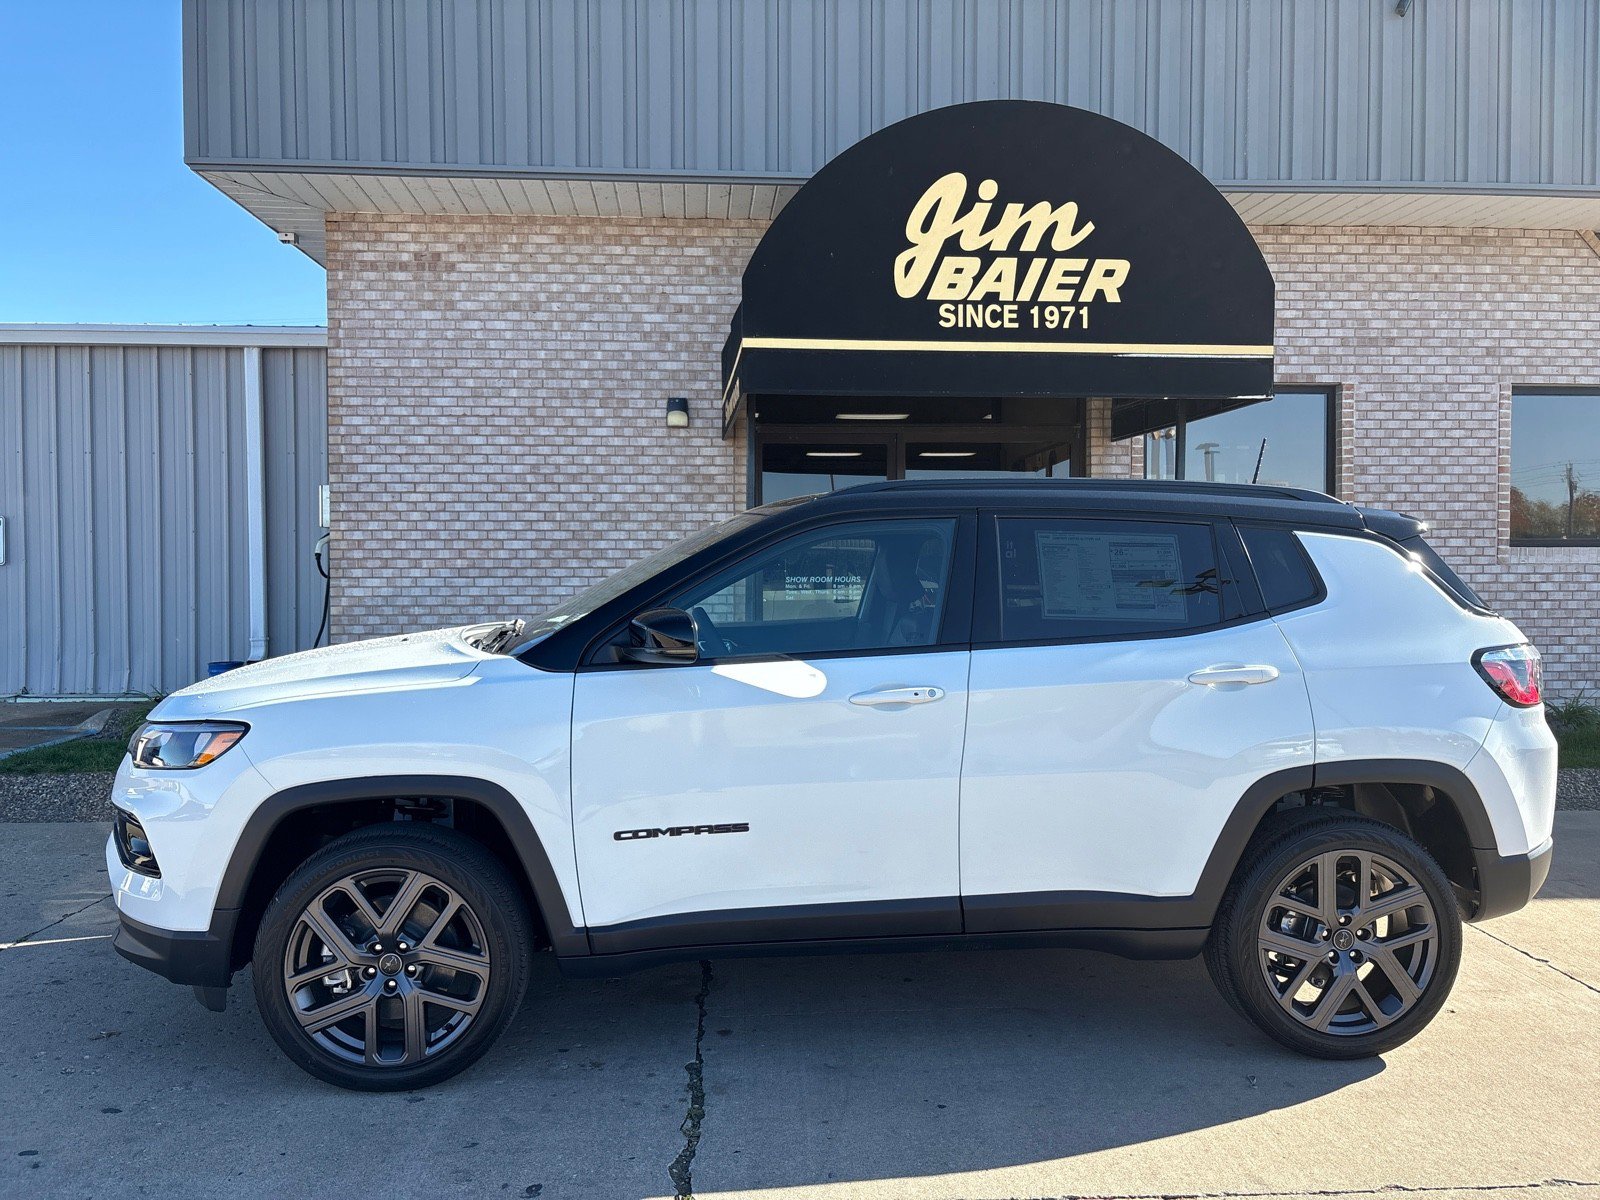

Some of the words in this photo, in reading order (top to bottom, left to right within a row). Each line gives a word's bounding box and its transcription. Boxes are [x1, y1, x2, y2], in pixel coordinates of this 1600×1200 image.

[893, 171, 1096, 299] Jim
[926, 256, 1131, 303] BAIER
[938, 303, 1020, 329] SINCE
[1029, 305, 1089, 329] 1971
[613, 822, 750, 841] COMPASS
